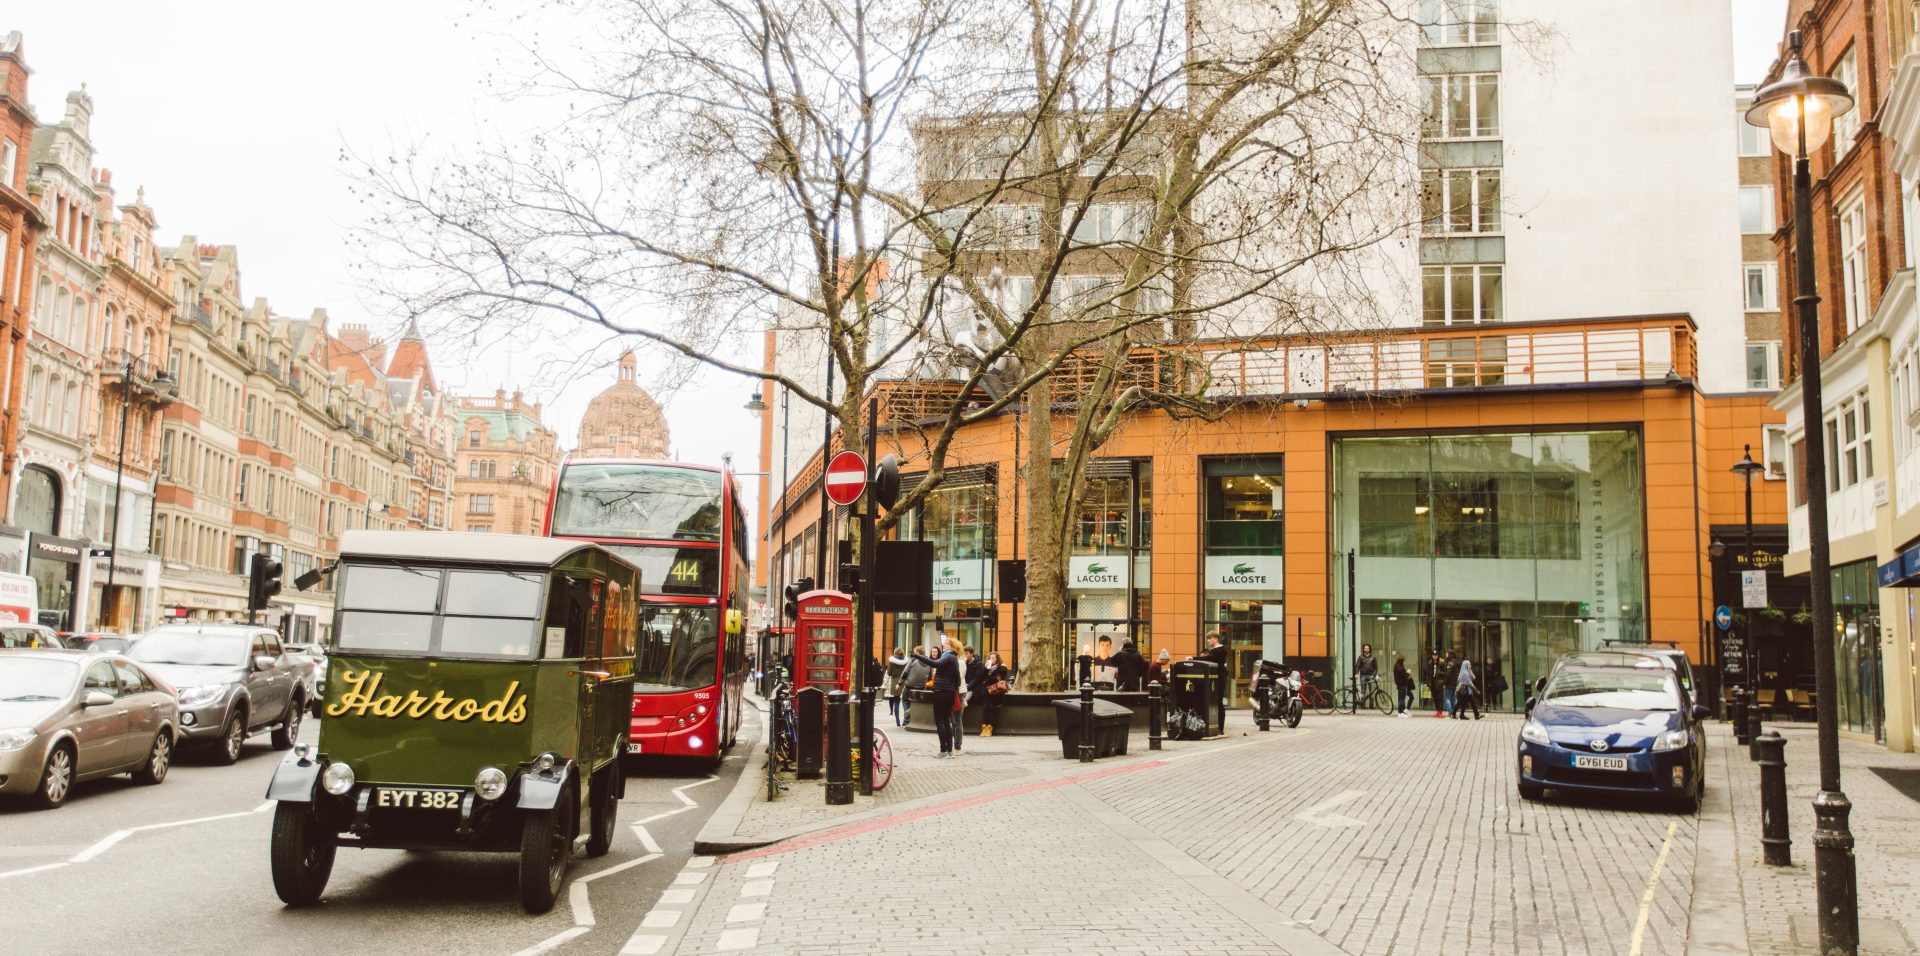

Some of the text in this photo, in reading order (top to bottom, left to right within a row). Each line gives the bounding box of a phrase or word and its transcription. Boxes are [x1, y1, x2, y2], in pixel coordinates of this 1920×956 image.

[1592, 480, 1606, 633] ONE KNIGHTSBRIDGE
[1737, 554, 1784, 563] Brndies
[670, 560, 699, 582] 414
[935, 577, 961, 585] LACOSTE
[1077, 575, 1119, 583] LACOSTE
[1222, 575, 1267, 584] LACOSTE
[808, 606, 848, 614] TELEPHONE
[325, 669, 527, 723] Harrods
[1579, 757, 1623, 769] GY61 EUD
[378, 790, 459, 809] EYT 382
